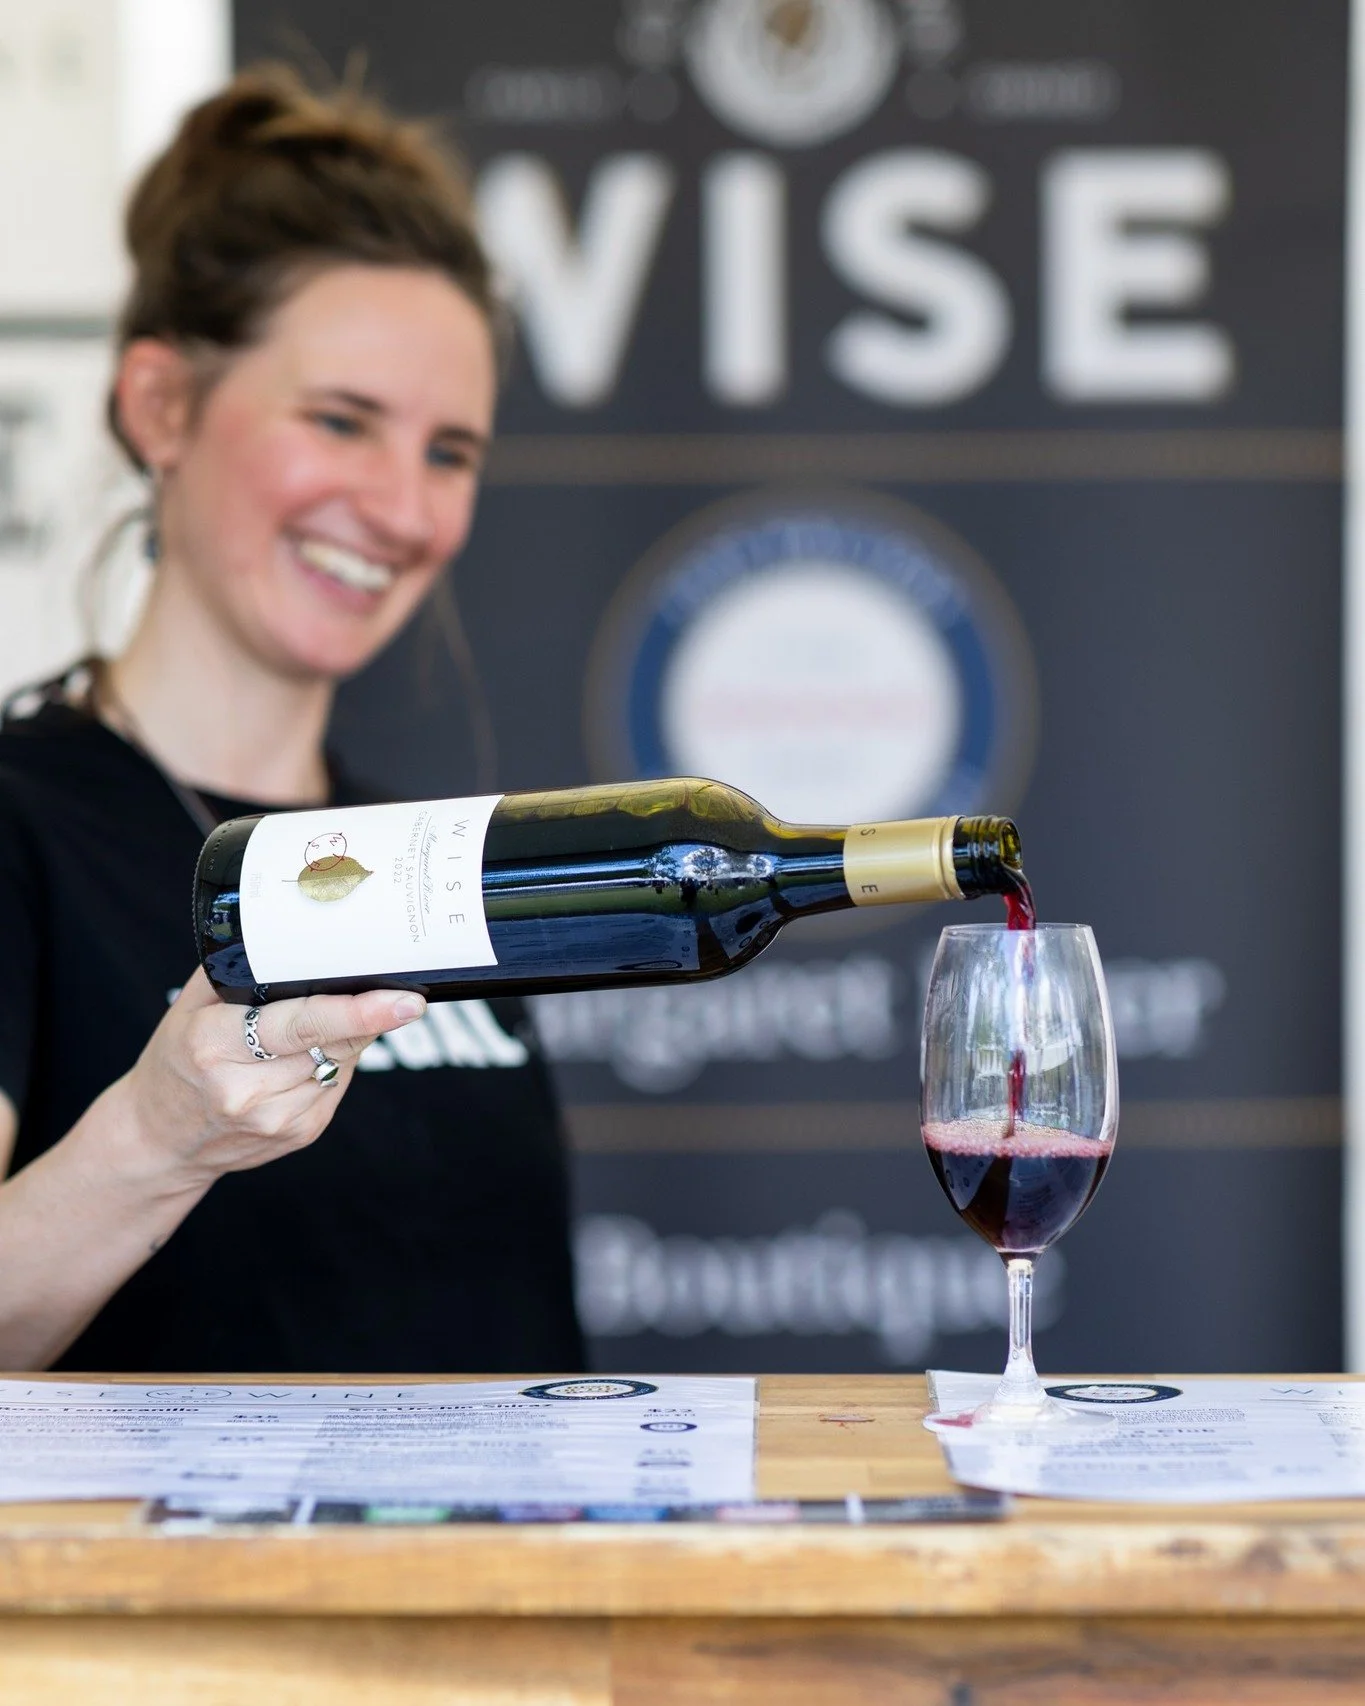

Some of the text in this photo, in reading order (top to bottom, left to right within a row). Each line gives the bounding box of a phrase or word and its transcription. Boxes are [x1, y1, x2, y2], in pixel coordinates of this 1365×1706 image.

[477, 147, 1237, 407] WISE
[393, 856, 404, 885] 2022
[405, 811, 428, 944] CABERNET SAUVIGNON
[421, 825, 441, 880] Margaret
[446, 818, 471, 925] WISE
